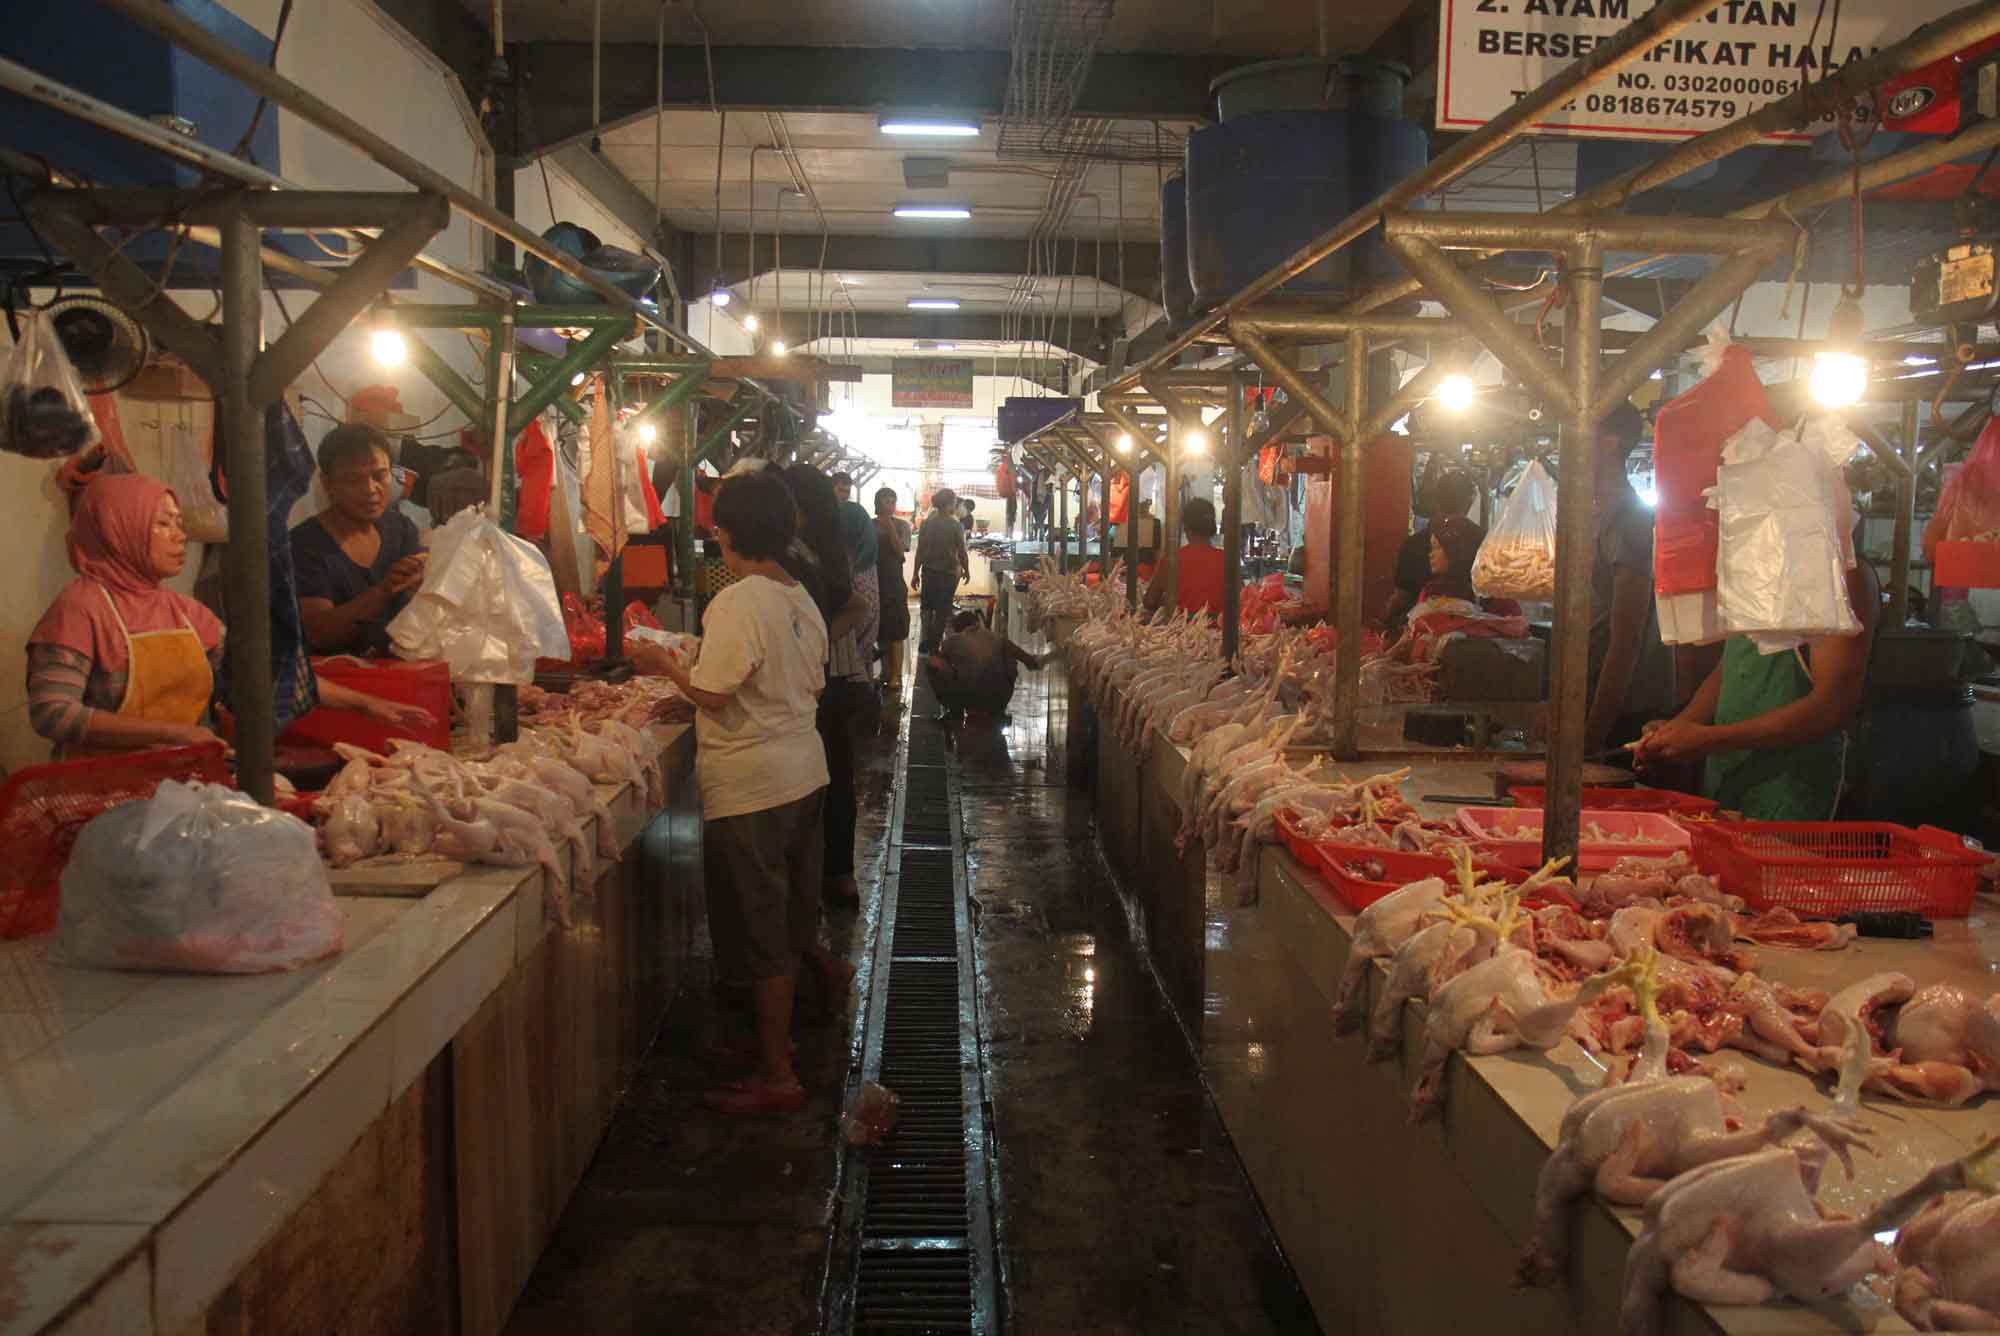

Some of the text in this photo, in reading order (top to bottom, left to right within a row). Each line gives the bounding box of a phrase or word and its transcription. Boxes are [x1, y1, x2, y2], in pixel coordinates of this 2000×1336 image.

[1524, 0, 1628, 19] AYAM
[1768, 43, 1881, 69] HALA
[1617, 72, 1656, 89] NO.
[1586, 94, 1736, 119] 0818674579
